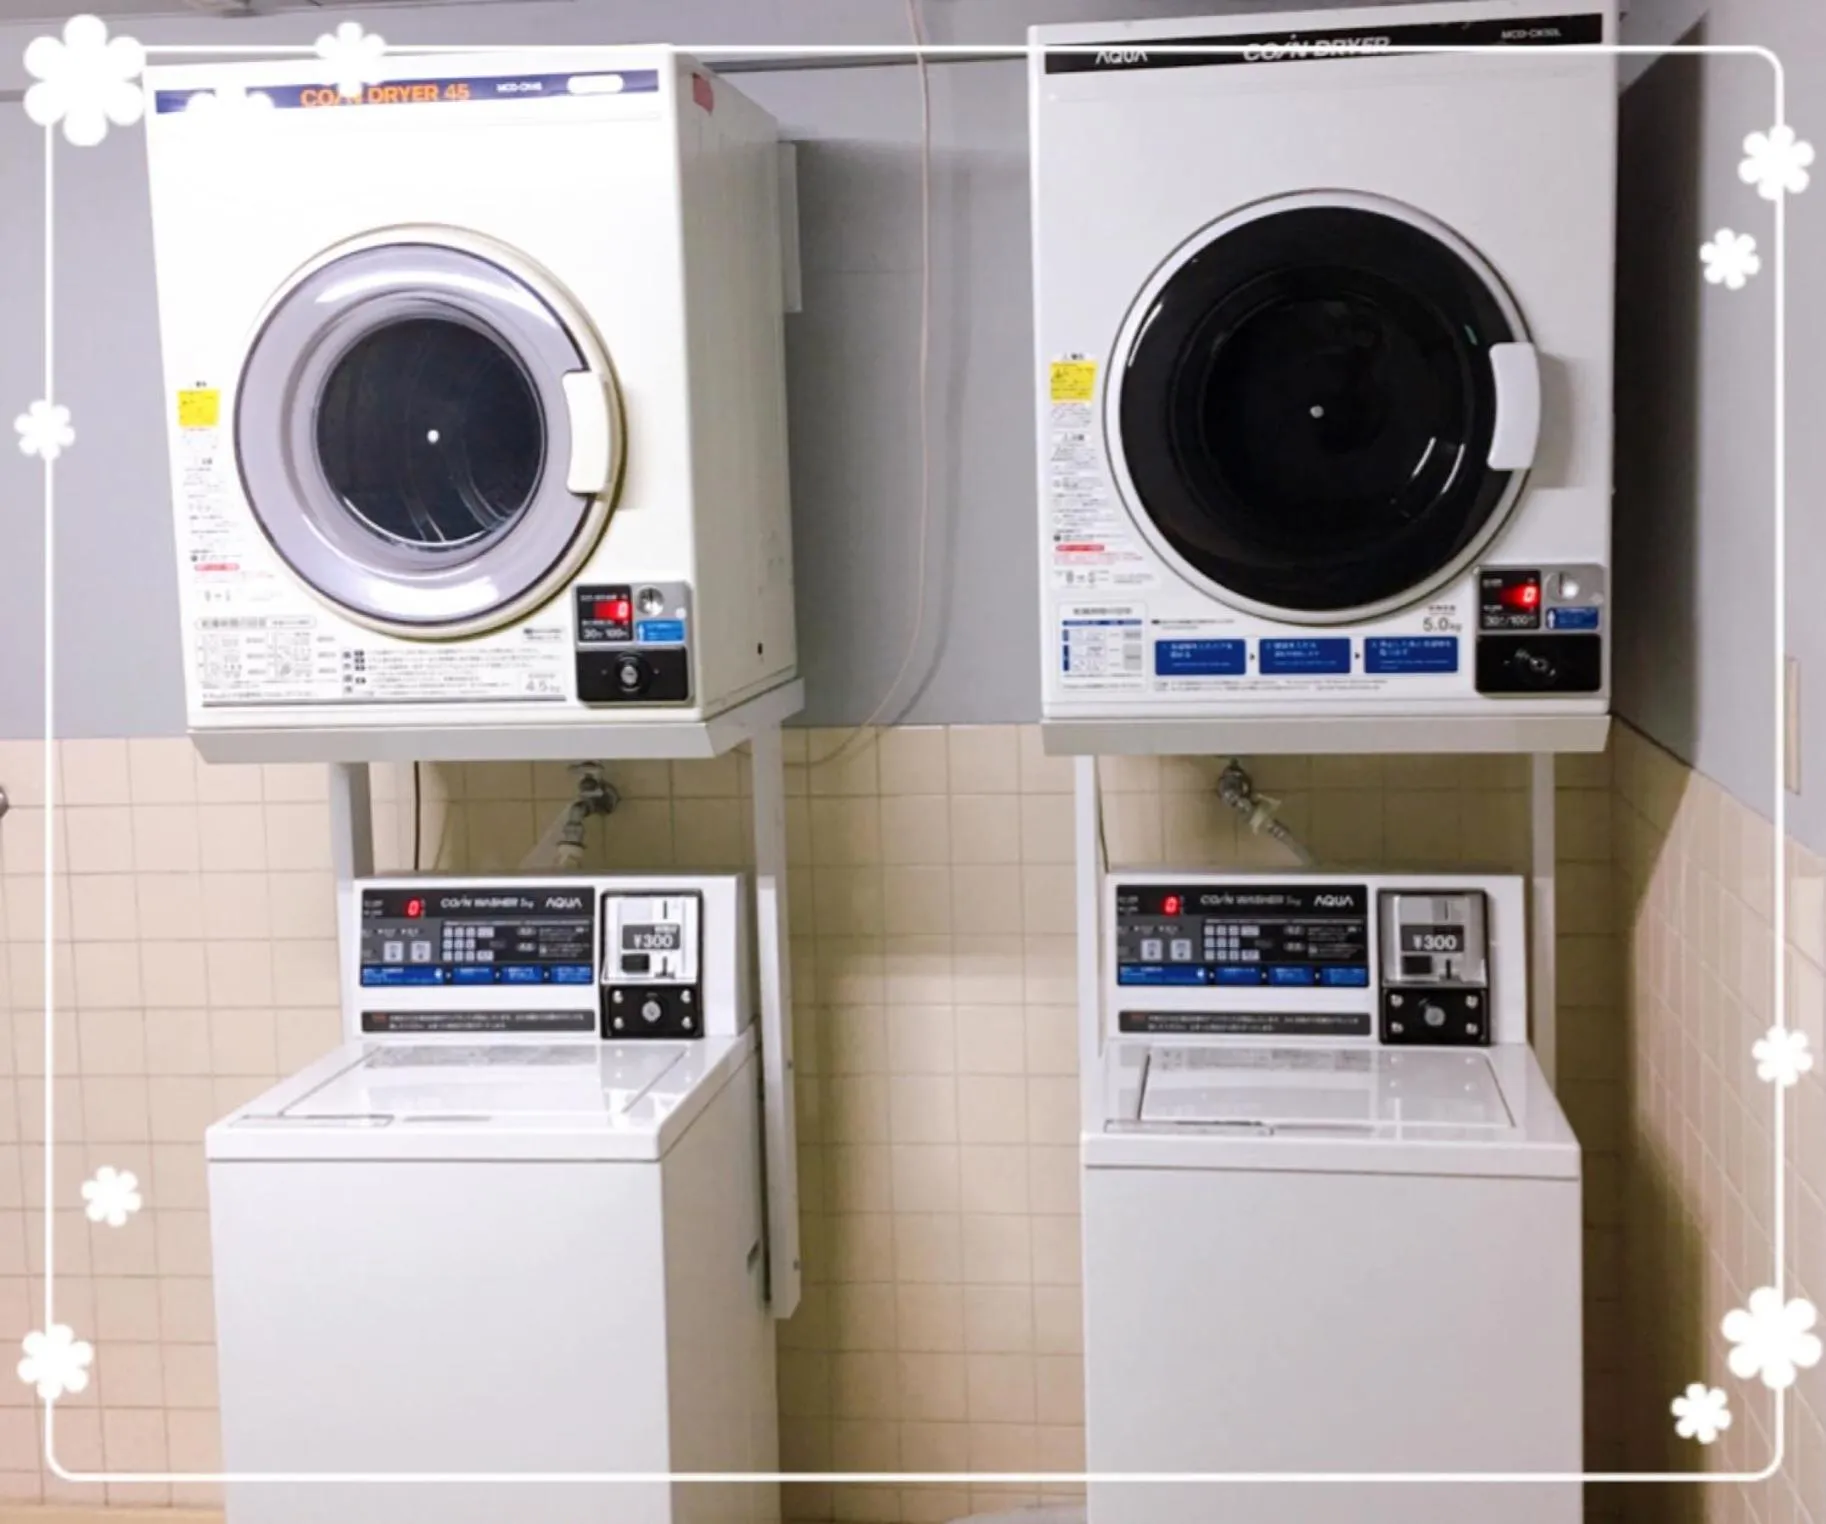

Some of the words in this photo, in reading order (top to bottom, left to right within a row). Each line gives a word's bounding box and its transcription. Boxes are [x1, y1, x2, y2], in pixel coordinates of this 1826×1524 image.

[367, 84, 439, 103] DRYER
[444, 82, 470, 101] 45
[407, 899, 420, 917] 0
[545, 896, 583, 909] AQUA
[1313, 894, 1354, 907] AQUA
[1412, 934, 1458, 951] ¥300
